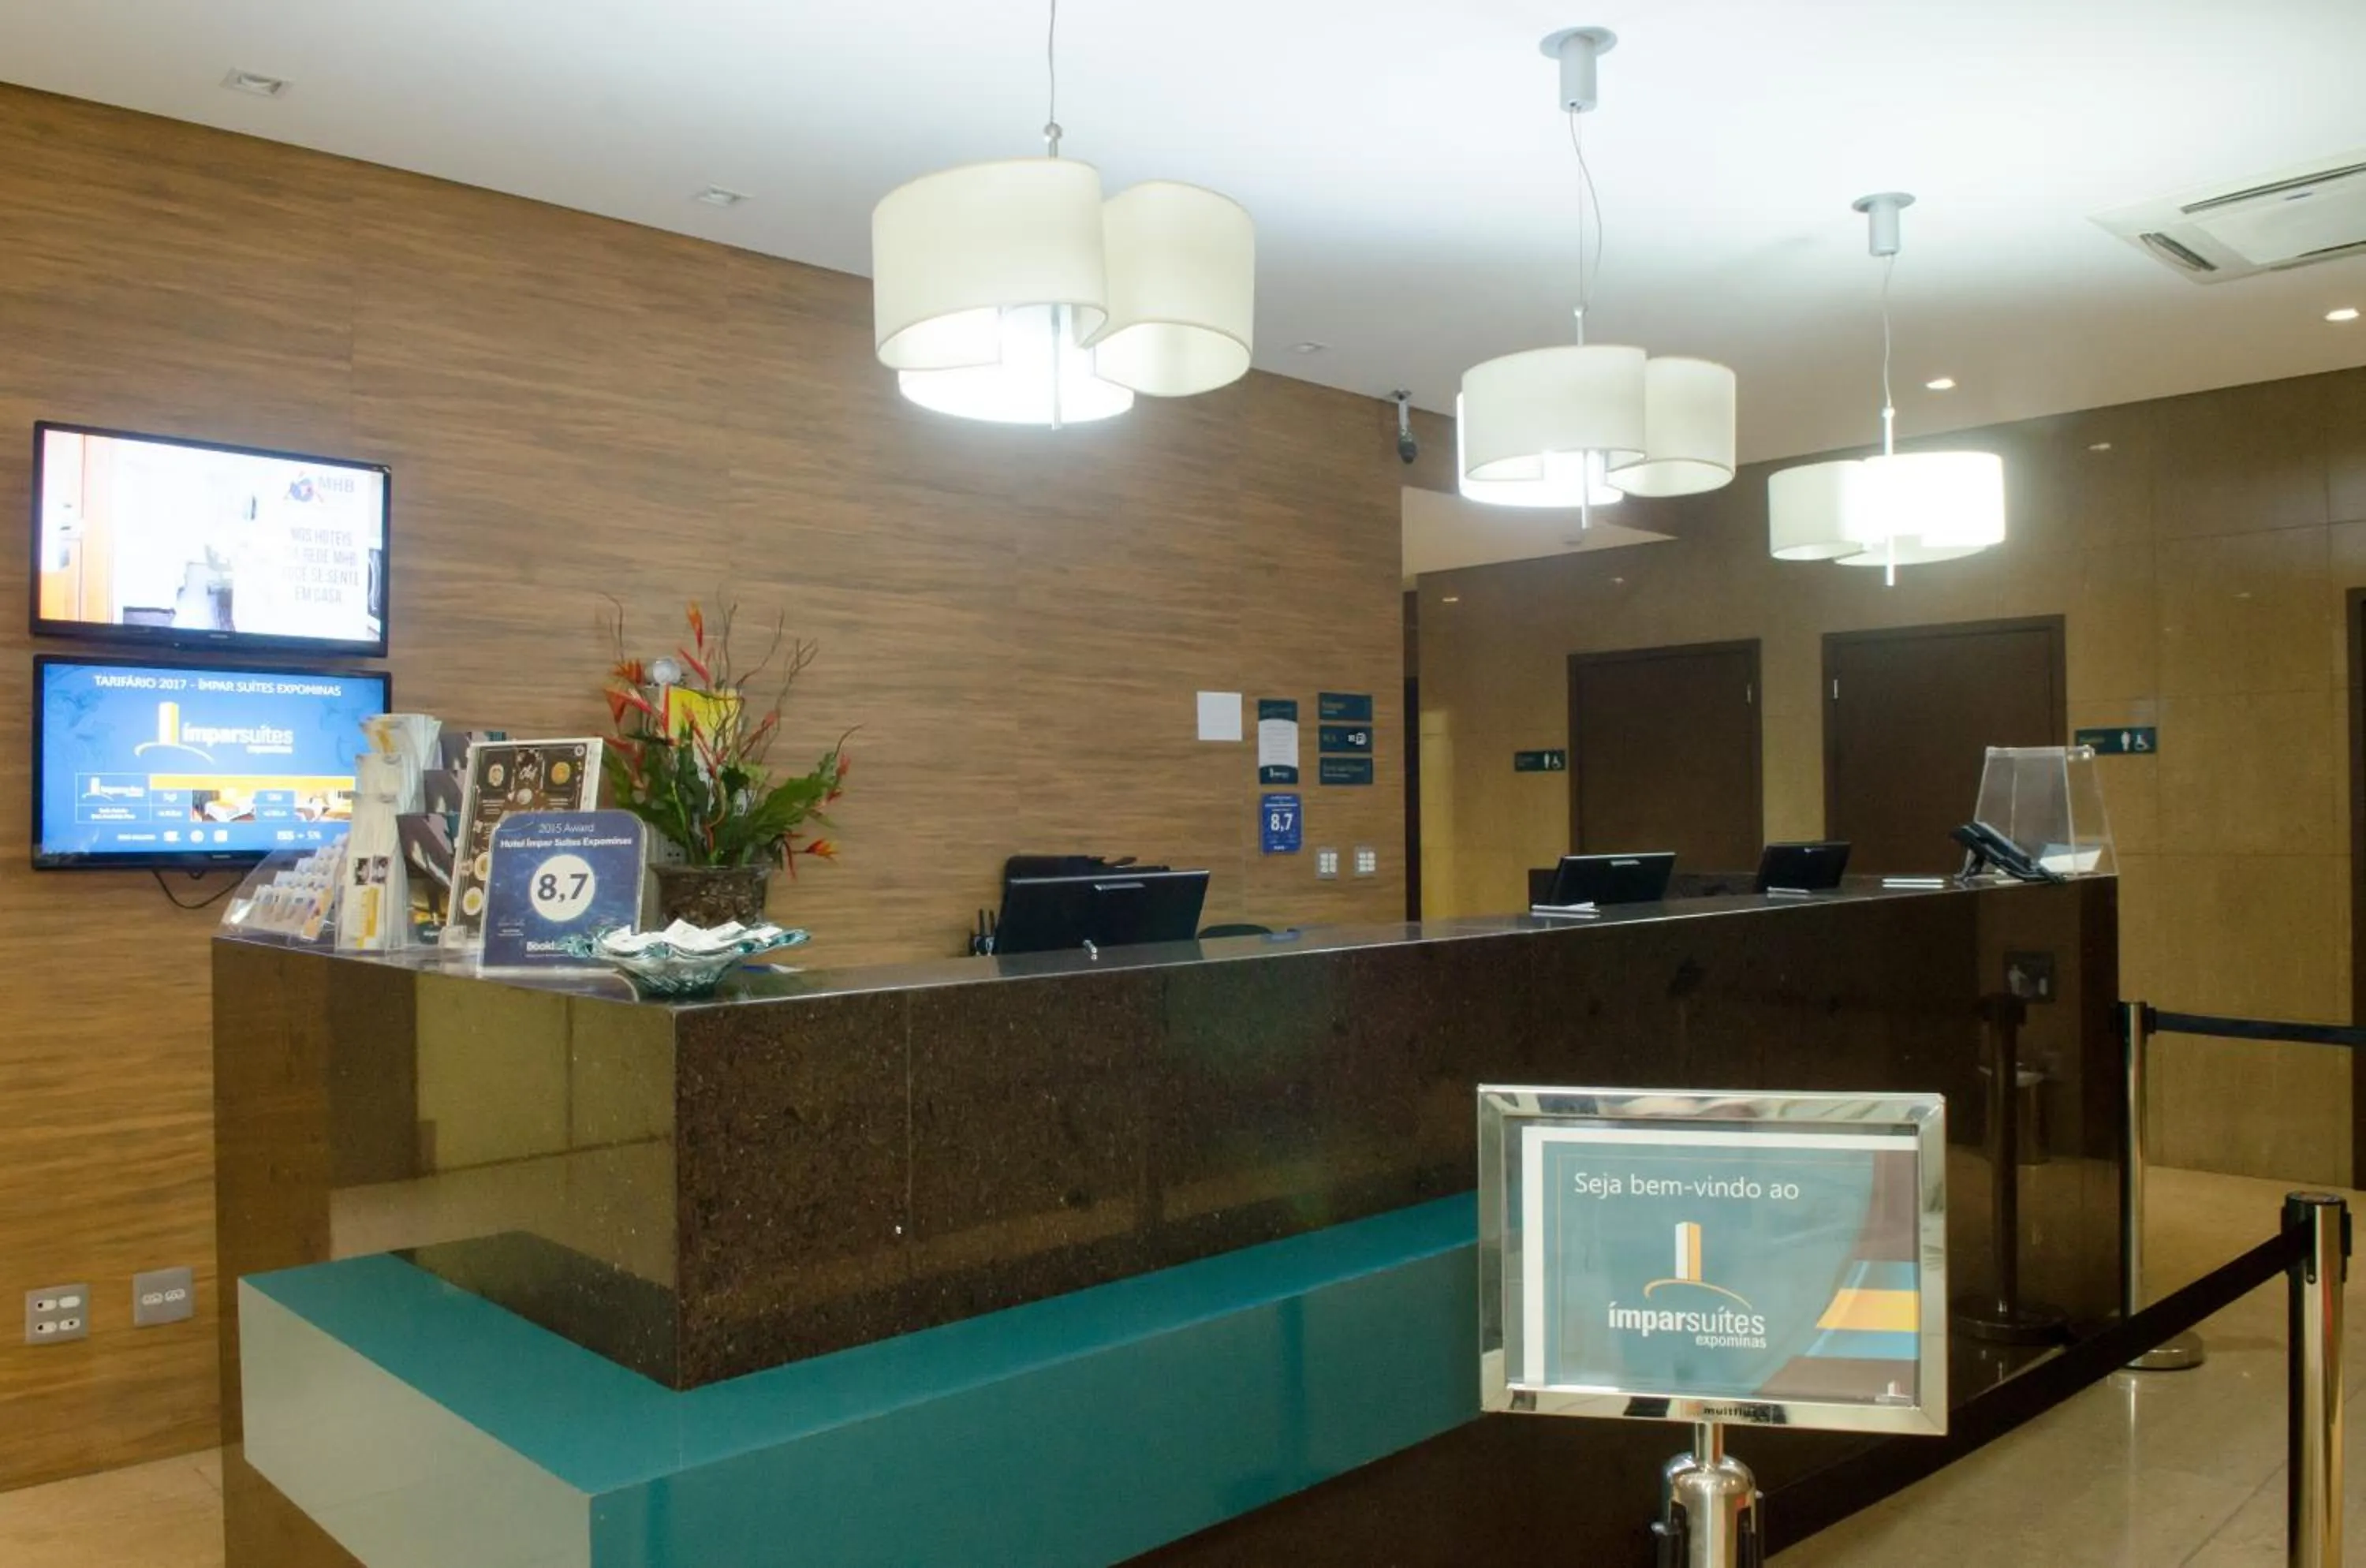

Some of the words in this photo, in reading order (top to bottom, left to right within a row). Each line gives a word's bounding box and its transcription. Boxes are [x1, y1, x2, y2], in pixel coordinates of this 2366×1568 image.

[158, 678, 187, 690] 2017
[277, 684, 341, 696] EXPOMINAS
[539, 823, 562, 834] 2015
[563, 823, 595, 833] Award
[1271, 812, 1293, 832] 8,7
[500, 838, 526, 848] Hotel
[536, 873, 589, 903] 8,7
[1574, 1171, 1622, 1200] Seja
[1629, 1173, 1762, 1199] bem-vindo
[1769, 1182, 1800, 1200] ao
[1696, 1333, 1767, 1350] expominas
